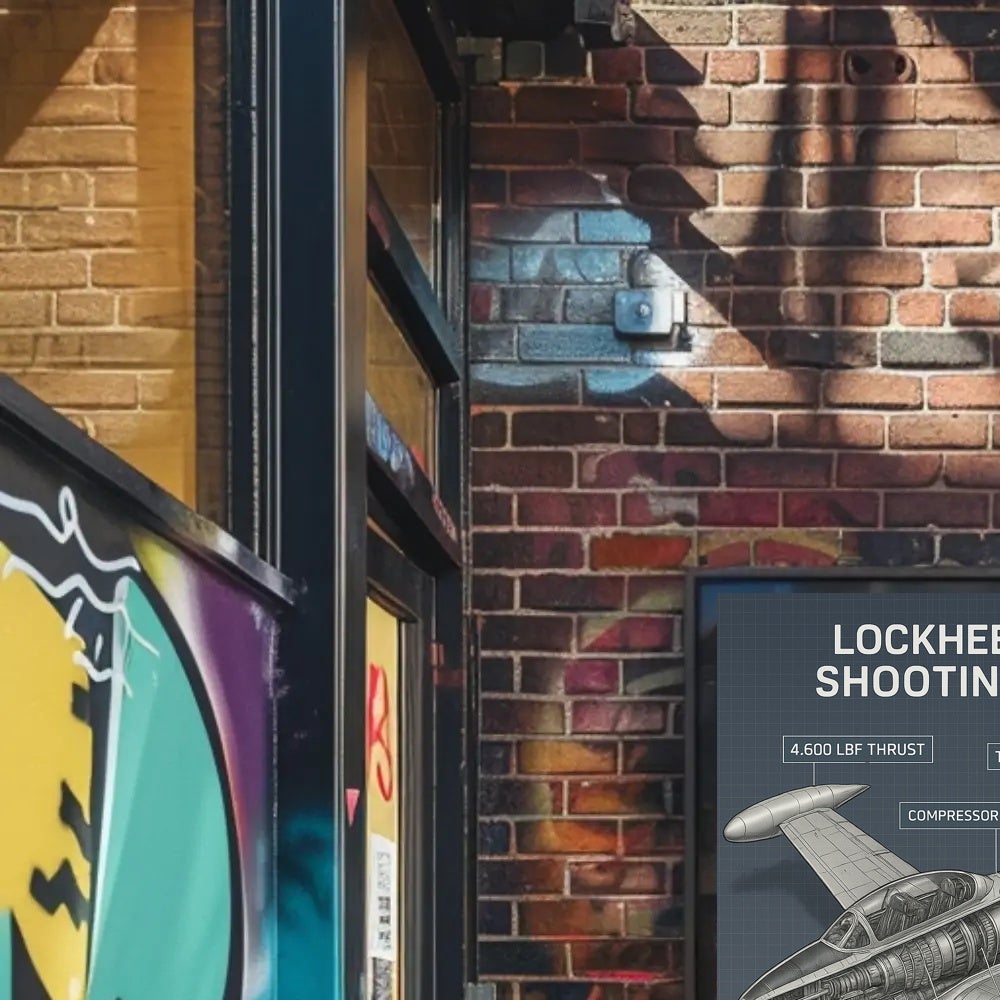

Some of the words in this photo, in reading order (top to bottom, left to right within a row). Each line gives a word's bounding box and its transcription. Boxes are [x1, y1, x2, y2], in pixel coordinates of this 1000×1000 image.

[790, 742, 832, 756] 4.600
[836, 743, 863, 756] LBF
[866, 742, 926, 756] THRUST
[908, 809, 999, 822] COMPRESSOR
